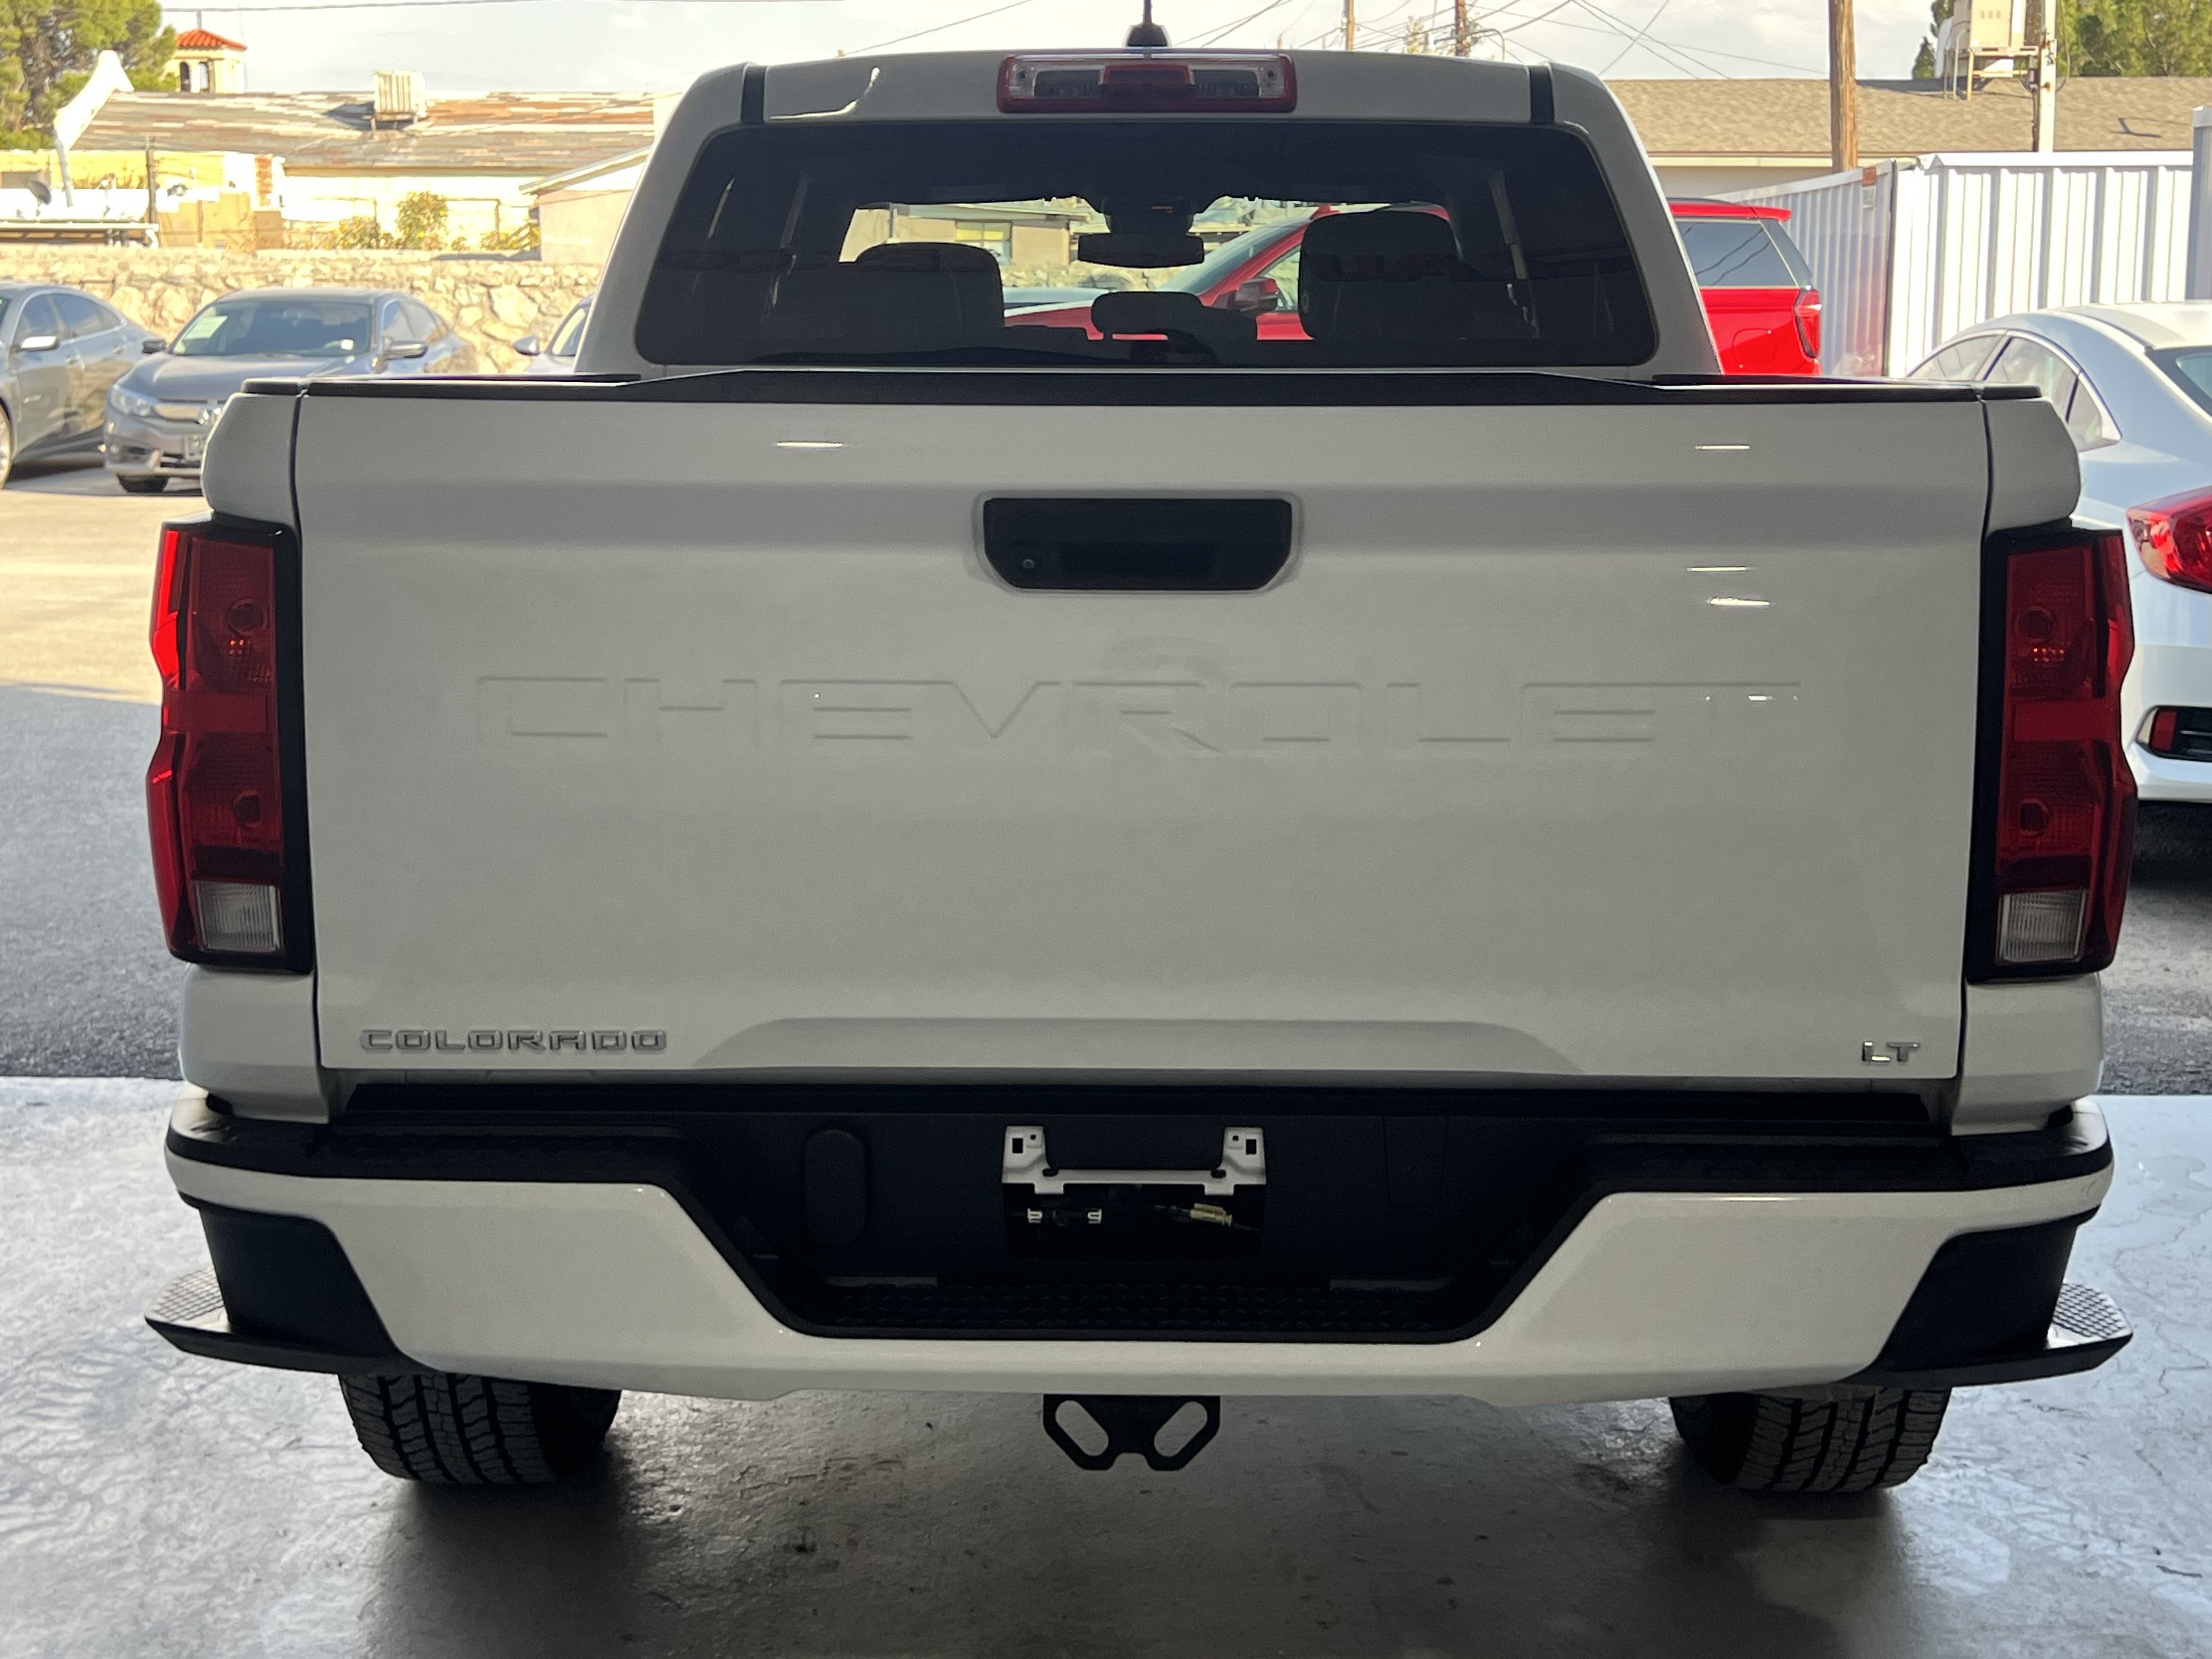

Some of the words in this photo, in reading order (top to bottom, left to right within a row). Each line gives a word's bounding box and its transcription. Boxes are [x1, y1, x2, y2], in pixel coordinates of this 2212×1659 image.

[476, 675, 1803, 757] CHEVROLET
[360, 1029, 667, 1053] COLORADO
[1861, 1041, 1920, 1063] LT
